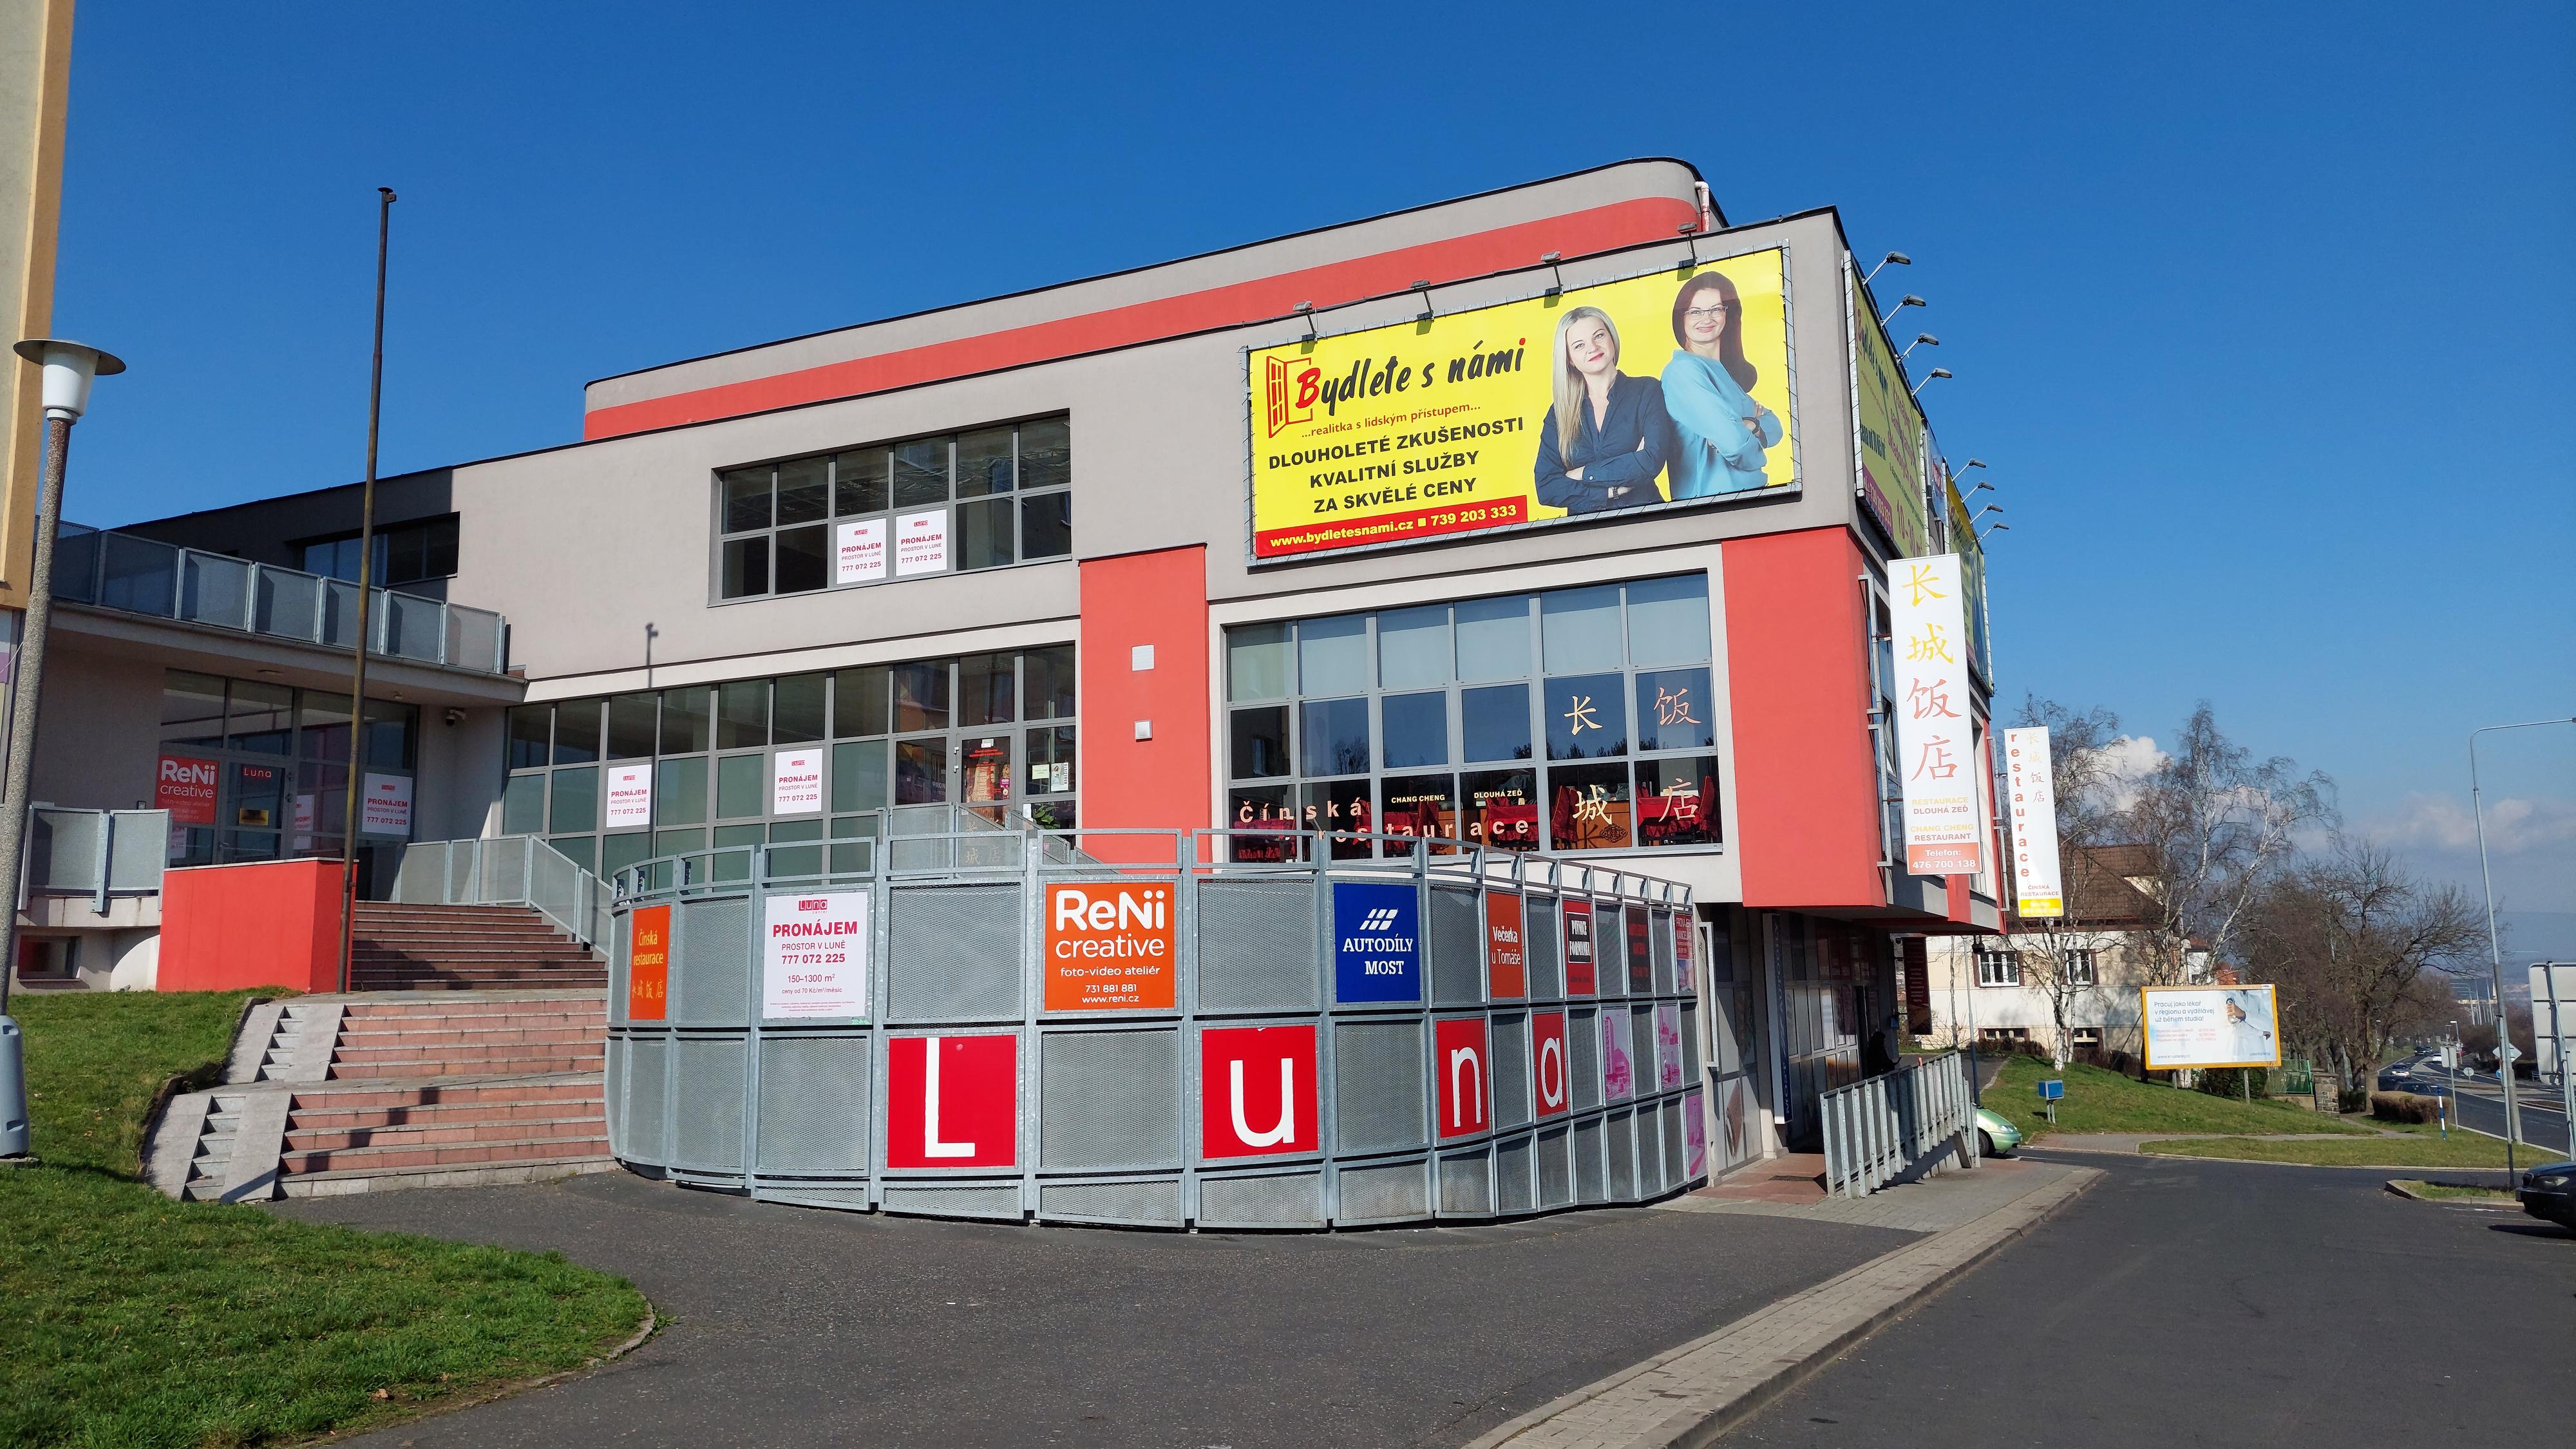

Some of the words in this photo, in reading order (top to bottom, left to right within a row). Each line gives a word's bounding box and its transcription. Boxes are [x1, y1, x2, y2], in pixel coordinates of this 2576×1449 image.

[1296, 356, 1411, 415] Bydlete
[1422, 363, 1435, 387] s
[1448, 337, 1526, 383] námi
[1365, 413, 1407, 428] lidským
[1269, 436, 1390, 469] DLOUHOLETÉ
[1397, 417, 1524, 450] ZKUŠENOSTI
[1310, 460, 1396, 488] KVALITNÍ
[1403, 450, 1479, 475] SLUŽBY
[1314, 498, 1338, 513] ZA
[1344, 483, 1417, 509] SKVĚLÉ
[1423, 477, 1477, 497] CENY
[1270, 520, 1414, 547] www.bydletesnami.cz
[1430, 514, 1456, 526] 739
[1460, 509, 1486, 523] 203
[1490, 504, 1517, 519] 333
[901, 534, 942, 545] PRONÁJEM
[842, 542, 882, 553] PRONÁJEM
[1902, 564, 1962, 782] 长城饭店
[244, 767, 272, 778] Luna
[779, 774, 818, 783] PRONÁJEM
[160, 784, 213, 799] creative
[611, 788, 647, 797] PRONÁJEM
[1473, 789, 1506, 799] DLOUHÁ
[1507, 788, 1522, 797] ZEĎ
[367, 798, 408, 808] PRONÁJEM
[1911, 797, 1969, 806] RESTAURACE
[2011, 734, 2029, 877] restaurace
[1239, 797, 1362, 823] Čínská
[1913, 806, 1949, 815] DLOUHÁ
[1951, 805, 1969, 813] ZEĎ
[799, 899, 828, 911] Luna
[773, 919, 858, 938] PRONÁJEM
[1492, 925, 1518, 943] Večerka
[1571, 920, 1587, 936] PIVNICE
[638, 928, 658, 946] Čínská
[1343, 933, 1414, 953] AUTODÍLY
[782, 942, 815, 951] PROSTOR
[824, 940, 846, 949] LUNĚ
[1055, 934, 1164, 958] creative
[633, 952, 664, 966] restaurace
[782, 954, 799, 964] 777
[802, 954, 822, 963] 072
[825, 953, 846, 963] 225
[1492, 952, 1496, 964] u
[1497, 949, 1521, 965] Tomáše
[1060, 966, 1122, 978] foto-video
[1124, 965, 1160, 976] ateliér
[1364, 961, 1405, 975] MOST
[1085, 984, 1101, 994] 731
[1103, 984, 1119, 993] 881
[1121, 983, 1137, 993] 881
[1082, 995, 1140, 1003] www.reni.cz
